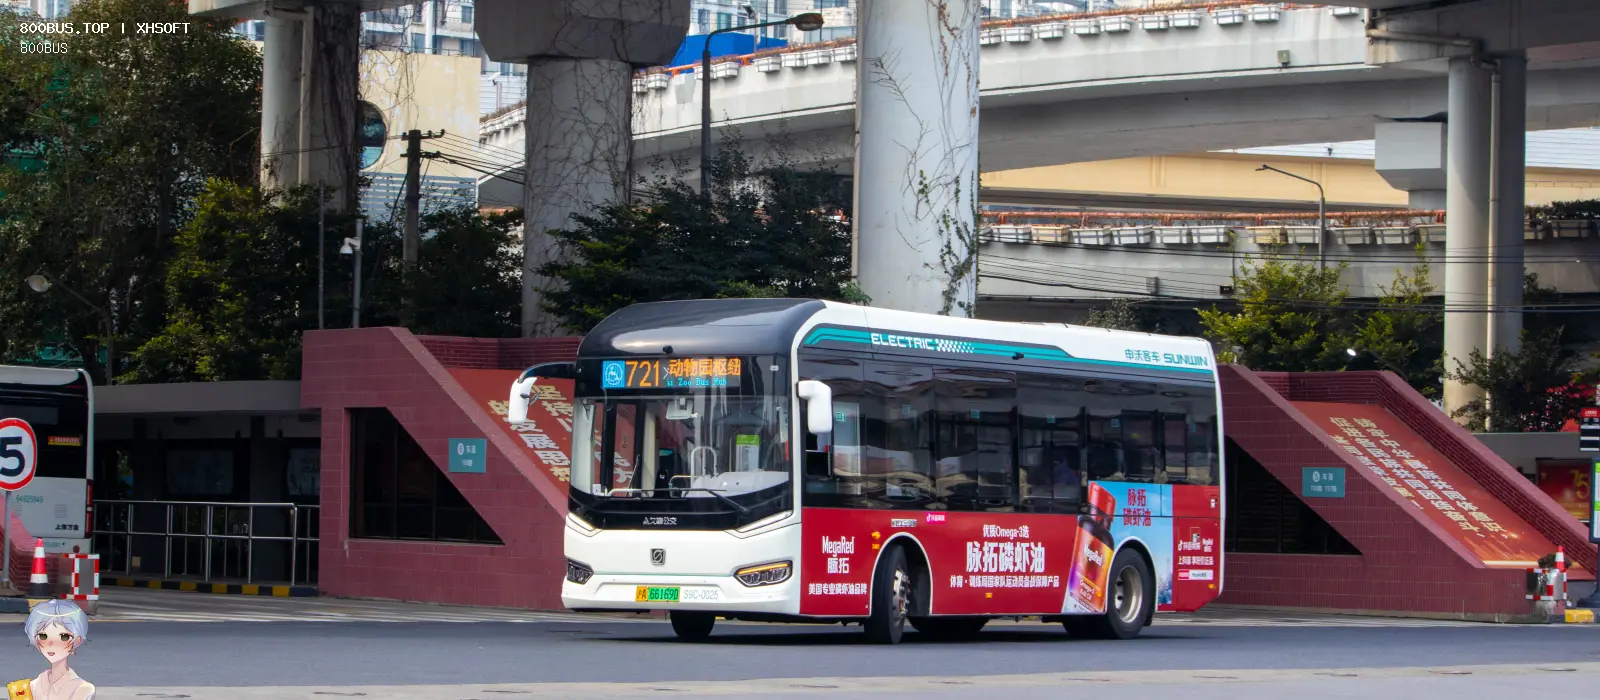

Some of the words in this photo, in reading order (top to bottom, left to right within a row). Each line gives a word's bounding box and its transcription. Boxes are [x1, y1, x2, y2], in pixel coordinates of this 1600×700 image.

[870, 332, 935, 350] ELECTRIC
[1124, 348, 1160, 362] 申沃客车
[1163, 353, 1208, 366] SUNWIN
[625, 360, 660, 387] 721
[669, 358, 741, 376] 动物园枢纽
[677, 377, 692, 386] Zoo
[696, 377, 709, 386] Bus
[712, 377, 727, 386] Hub
[0, 436, 26, 477] 5
[1127, 487, 1146, 506] 脉拓
[1123, 508, 1151, 527] 磷虾油
[822, 535, 855, 557] MegaRed
[827, 557, 850, 574] 脉拓
[966, 541, 1045, 573] 脉拓磷虾油
[684, 589, 719, 600] S9C-0025
[808, 583, 868, 595] 美国专业磷虾油品牌
